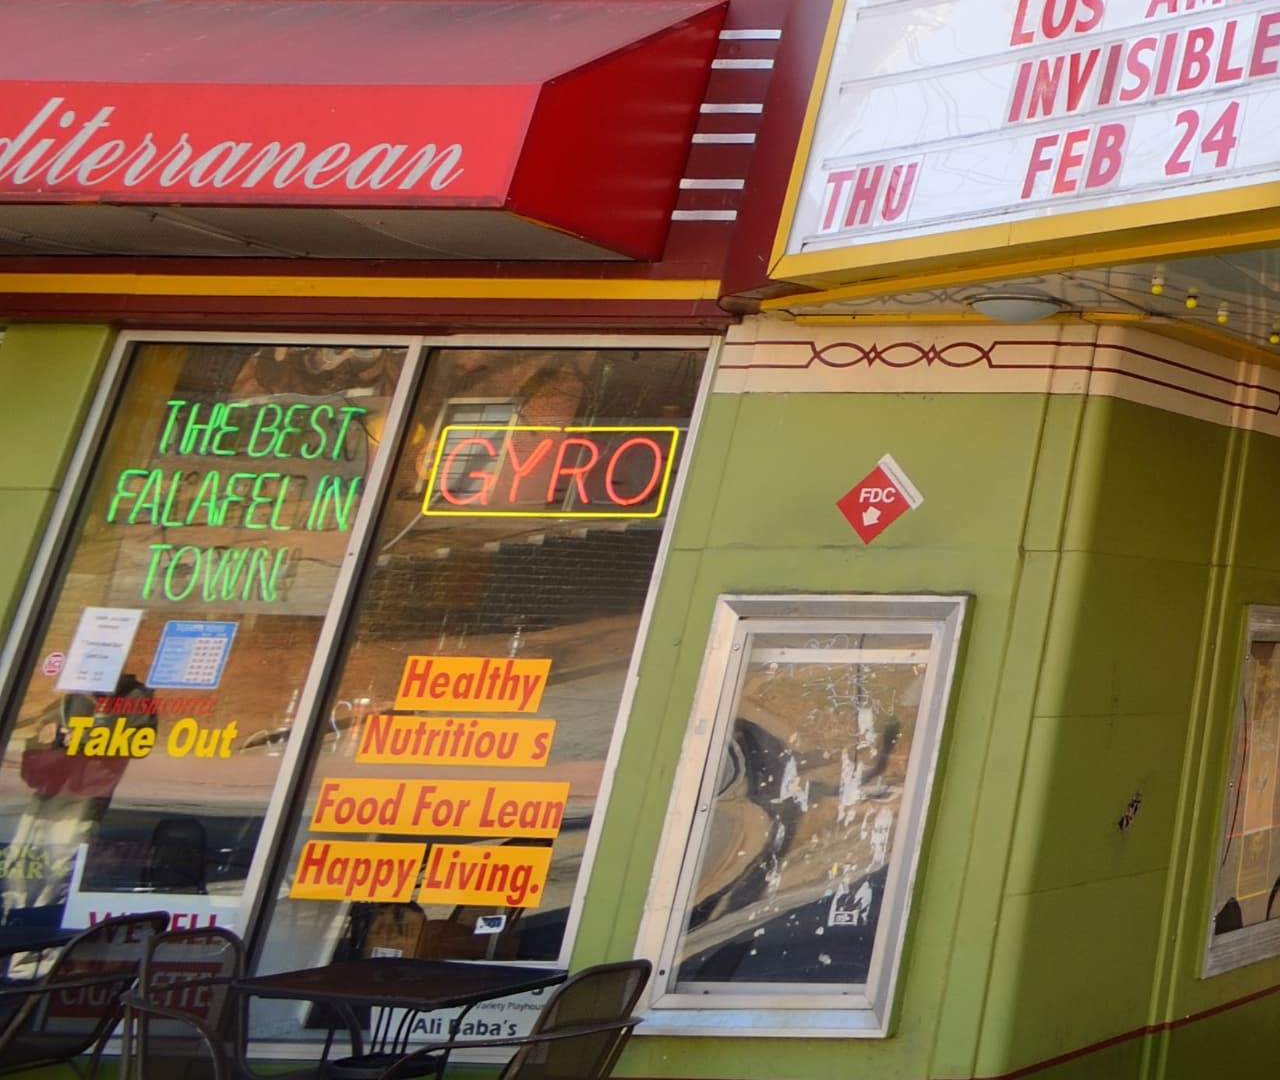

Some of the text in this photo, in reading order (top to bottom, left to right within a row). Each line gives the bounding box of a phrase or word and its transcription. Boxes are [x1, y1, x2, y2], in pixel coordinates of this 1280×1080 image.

[821, 162, 918, 230] THU
[1021, 129, 1123, 199] FEB
[1164, 102, 1241, 175] 24
[159, 400, 367, 460] THE BEST
[107, 468, 364, 531] FALAFEL IN
[440, 437, 663, 506] GYRO
[859, 487, 896, 503] FDC
[141, 544, 288, 602] TOWN
[402, 658, 541, 711] Healthy
[66, 716, 239, 759] Take Out
[315, 783, 564, 829] Food For Lean
[297, 843, 540, 906] Happy Living.
[411, 1018, 441, 1035] Ali
